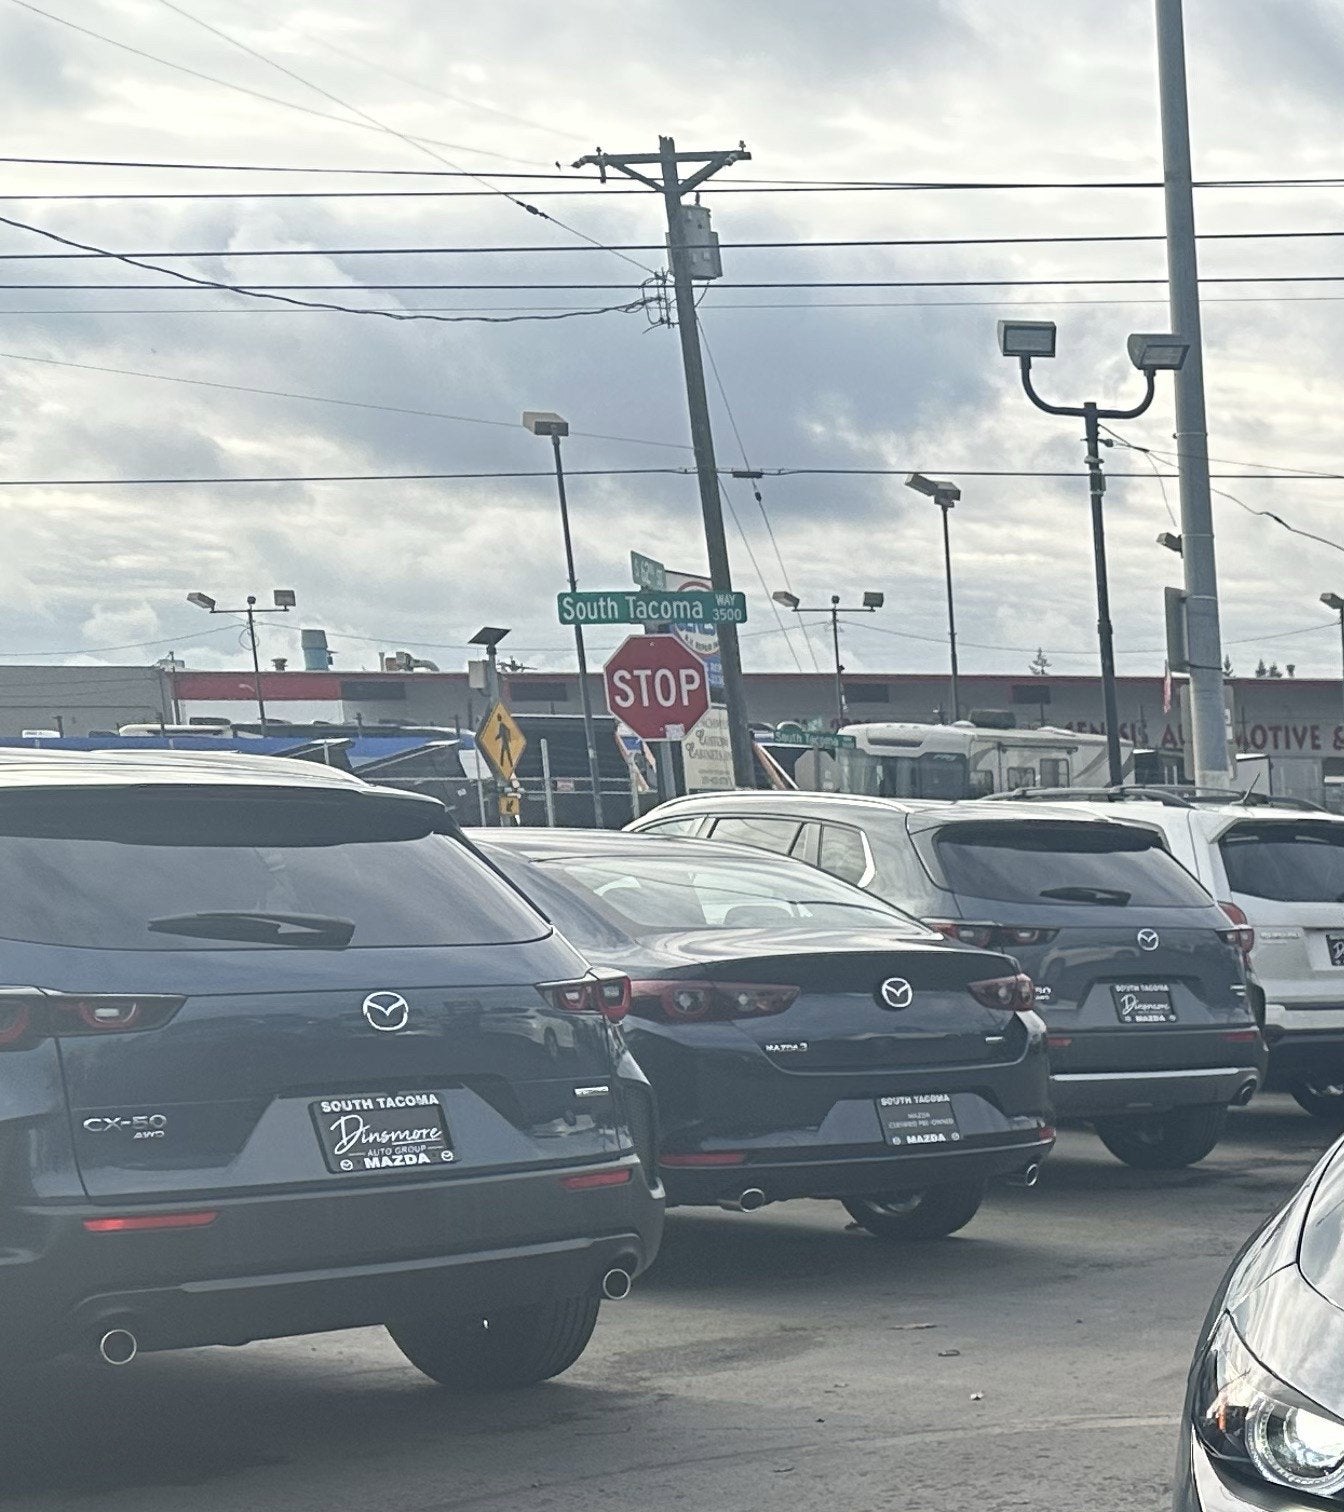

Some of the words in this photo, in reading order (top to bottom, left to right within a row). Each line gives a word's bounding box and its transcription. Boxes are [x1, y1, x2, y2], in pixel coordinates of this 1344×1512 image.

[562, 597, 619, 621] South
[625, 596, 704, 620] Tacoma
[715, 593, 737, 606] WAY
[712, 608, 742, 621] 3500
[612, 668, 701, 708] STOP
[321, 1098, 374, 1113] SOUTH
[376, 1093, 440, 1108] TACOMA
[881, 1096, 912, 1106] SOUTH
[914, 1093, 951, 1104] TACOMA
[83, 1114, 167, 1132] CX-50
[133, 1130, 165, 1139] AWD
[330, 1114, 442, 1155] Dinsmore
[906, 1133, 946, 1144] MAZDA
[367, 1147, 392, 1156] AUTO
[394, 1145, 426, 1154] GROUP
[364, 1153, 431, 1169] MAZDA
